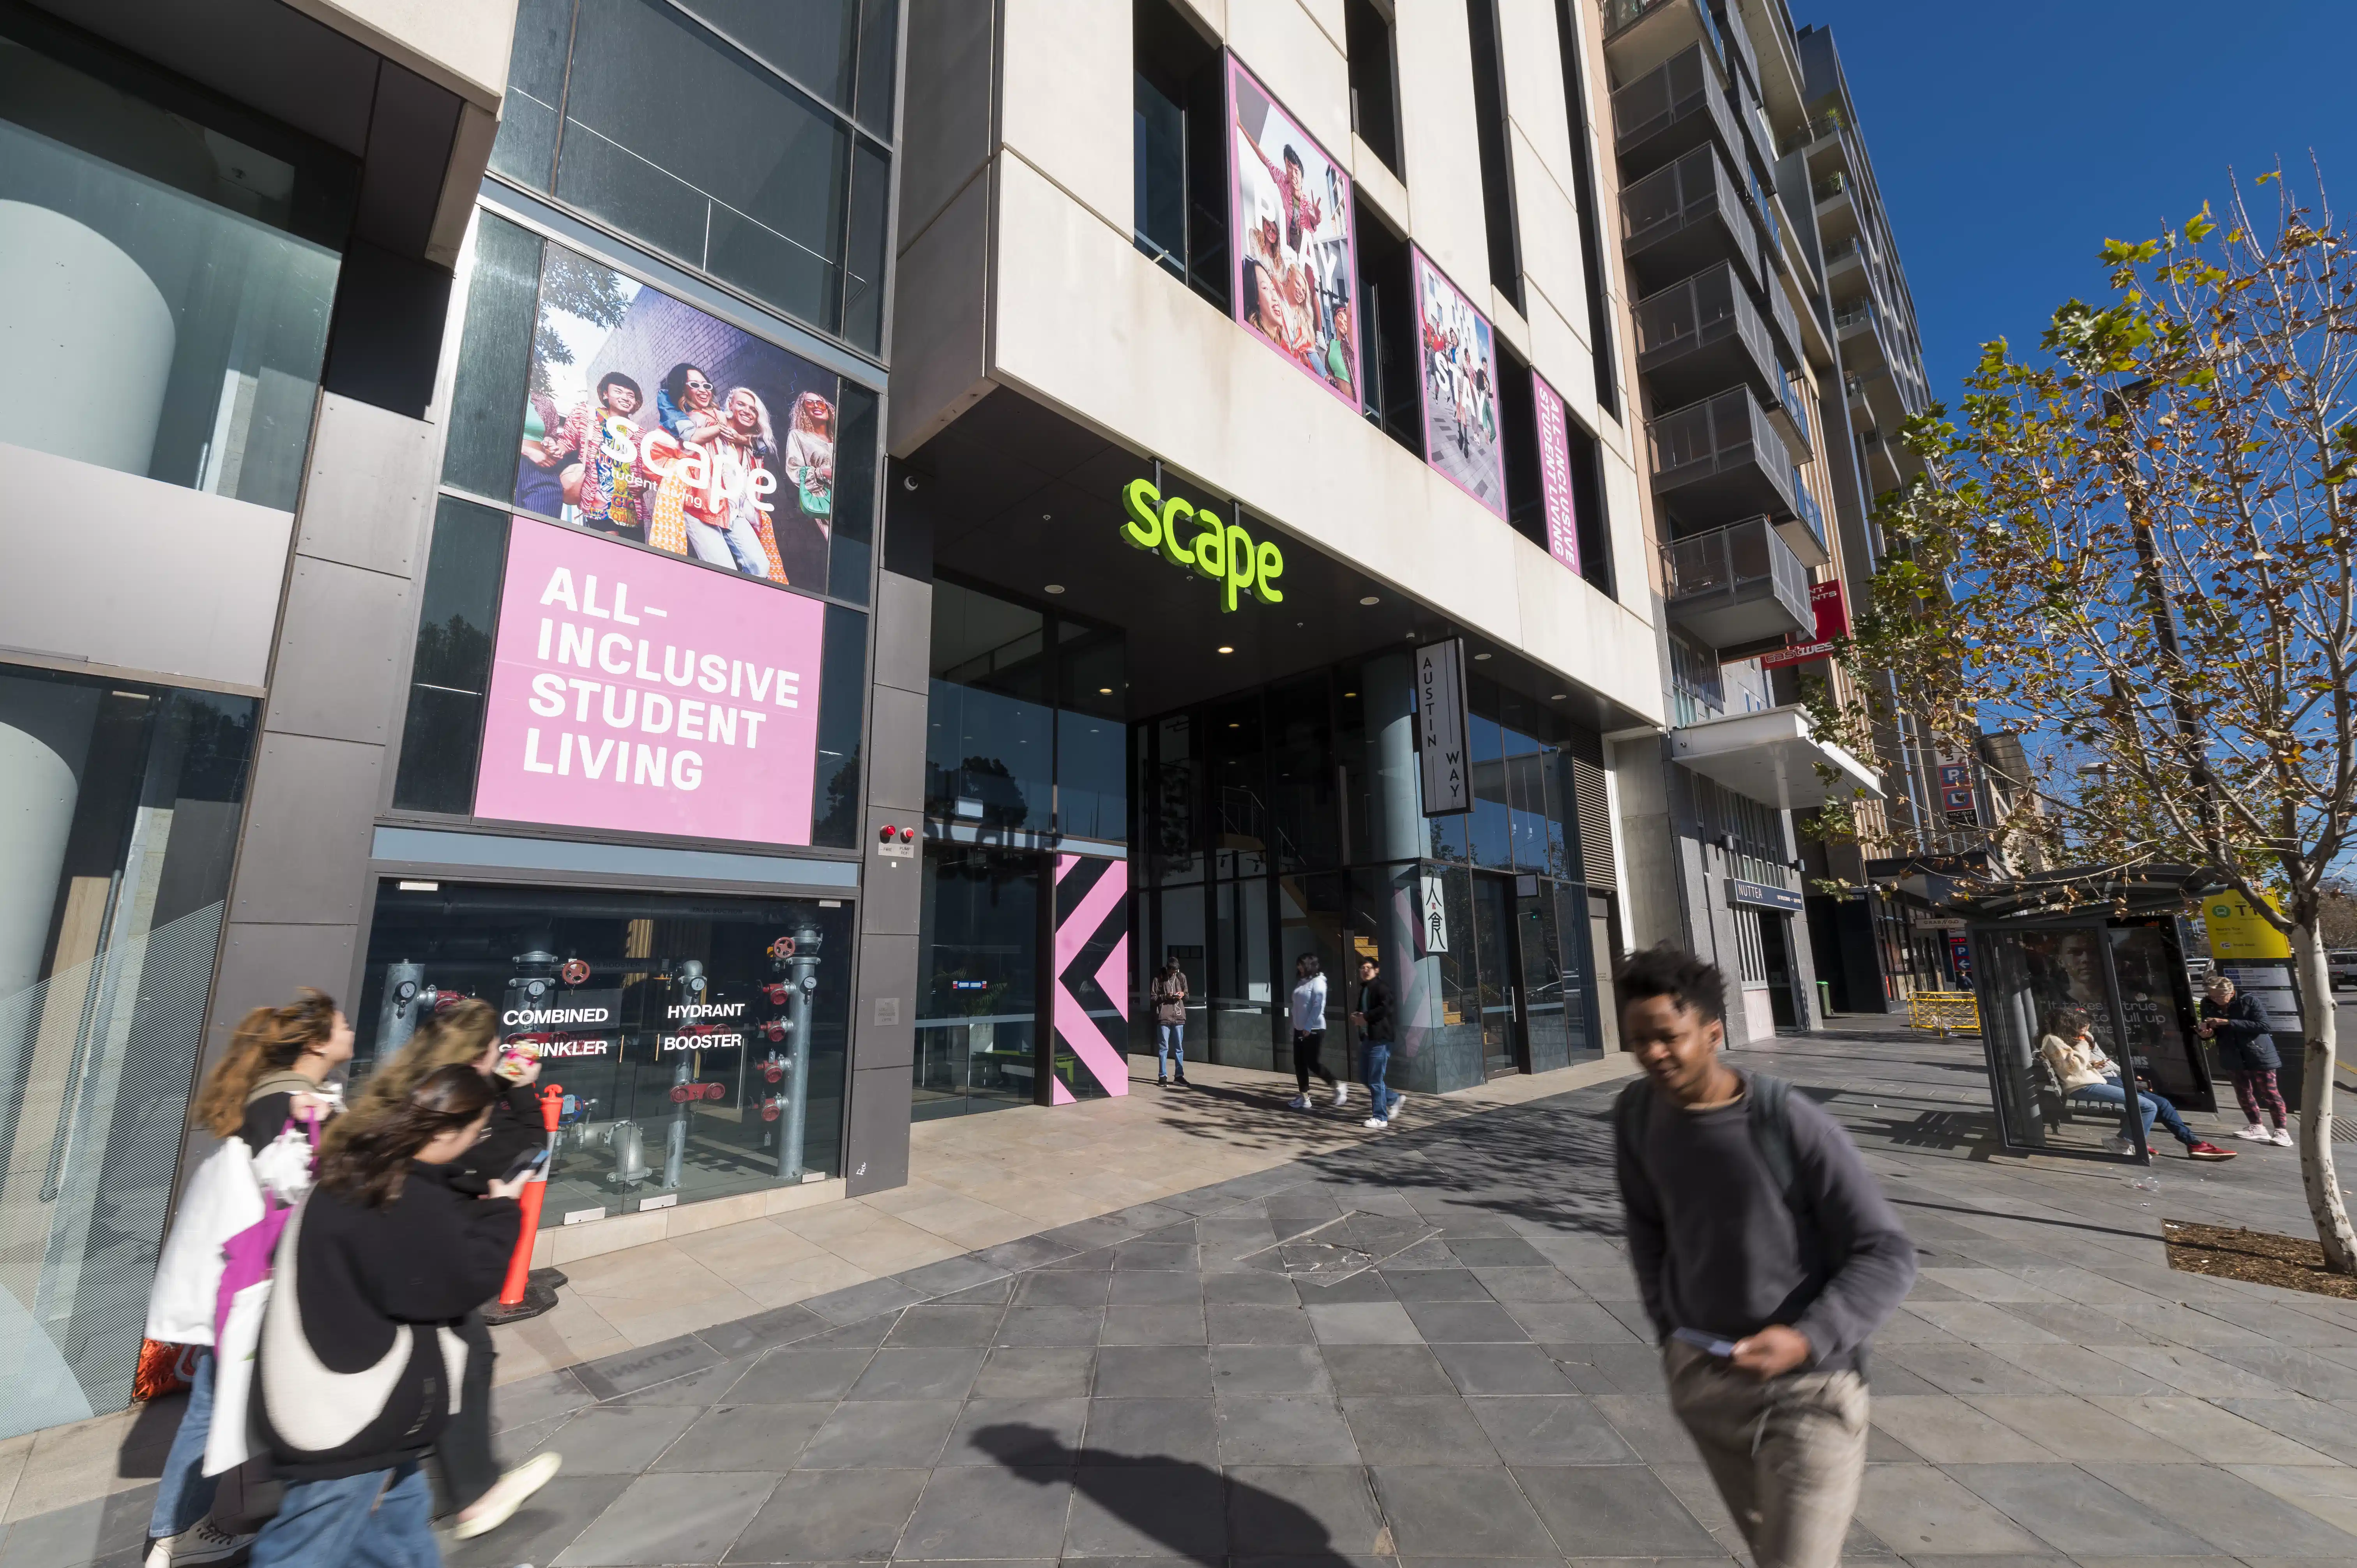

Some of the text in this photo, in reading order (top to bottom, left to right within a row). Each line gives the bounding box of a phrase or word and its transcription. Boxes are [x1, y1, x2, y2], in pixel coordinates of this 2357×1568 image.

[1254, 182, 1338, 292] PLAY
[1435, 351, 1486, 424] STAY
[598, 463, 659, 493] Student
[600, 416, 777, 514] scape
[1539, 387, 1564, 557] STUDENT LIVING
[1549, 396, 1575, 566] ALL-INCLUSIVE
[1120, 479, 1283, 614] scape
[537, 618, 800, 708] INCLUSIVE
[528, 673, 766, 749] STUDENT
[1422, 656, 1460, 798] AUSTIN WAY
[523, 727, 703, 791] LIVING
[1738, 884, 1763, 899] NUTTEA
[503, 1008, 609, 1026] COMBINED
[664, 1033, 742, 1051] BOOSTER
[668, 1003, 745, 1019] HYDRANT
[2122, 1001, 2157, 1011] true
[2123, 1012, 2140, 1022] ull
[2145, 1014, 2166, 1024] up
